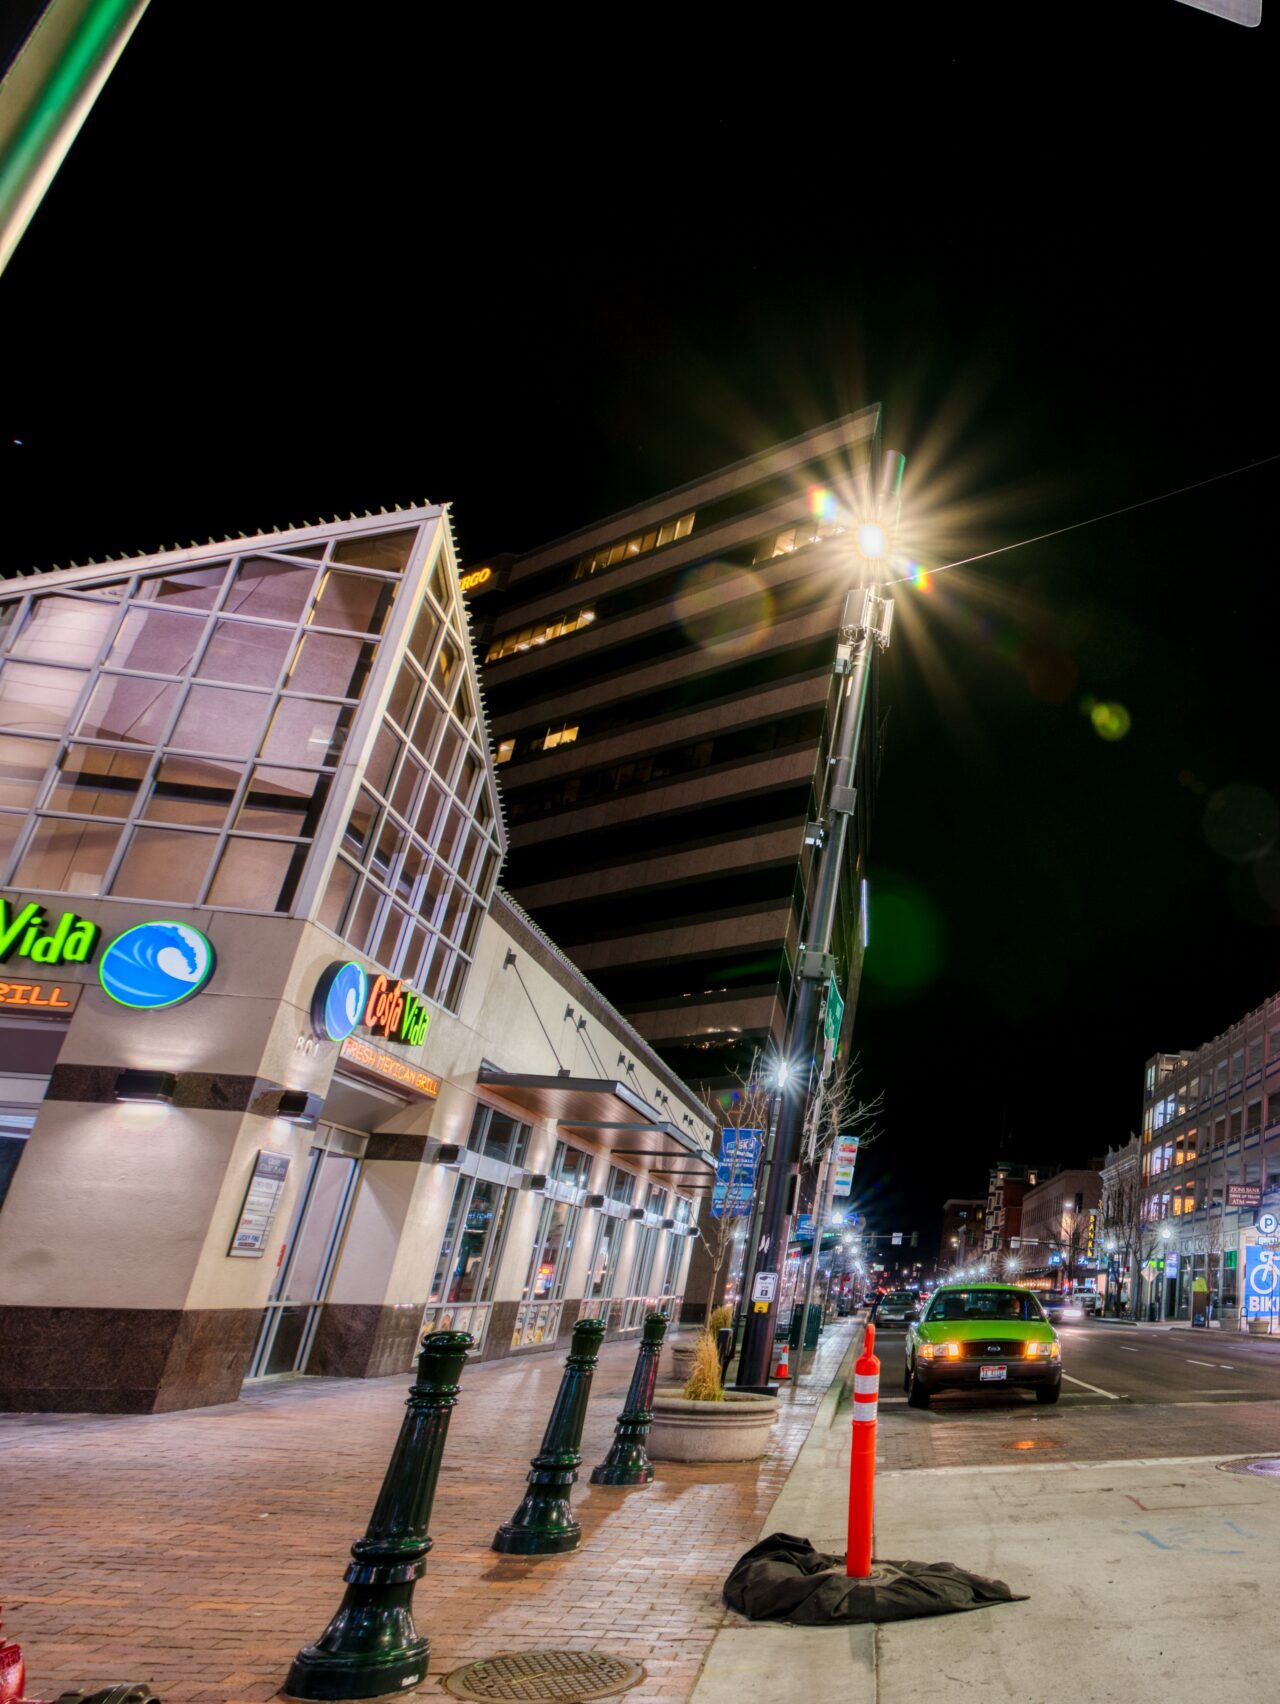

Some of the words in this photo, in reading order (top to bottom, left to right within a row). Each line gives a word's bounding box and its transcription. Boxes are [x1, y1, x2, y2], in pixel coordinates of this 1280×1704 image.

[0, 899, 96, 964] Vida
[365, 975, 403, 1037] Costa
[402, 991, 429, 1047] Vida
[296, 1037, 319, 1057] 801
[345, 1037, 376, 1065] FRESH
[377, 1055, 416, 1084] MEXICAN
[416, 1071, 438, 1095] GRILL
[1264, 1217, 1273, 1229] P
